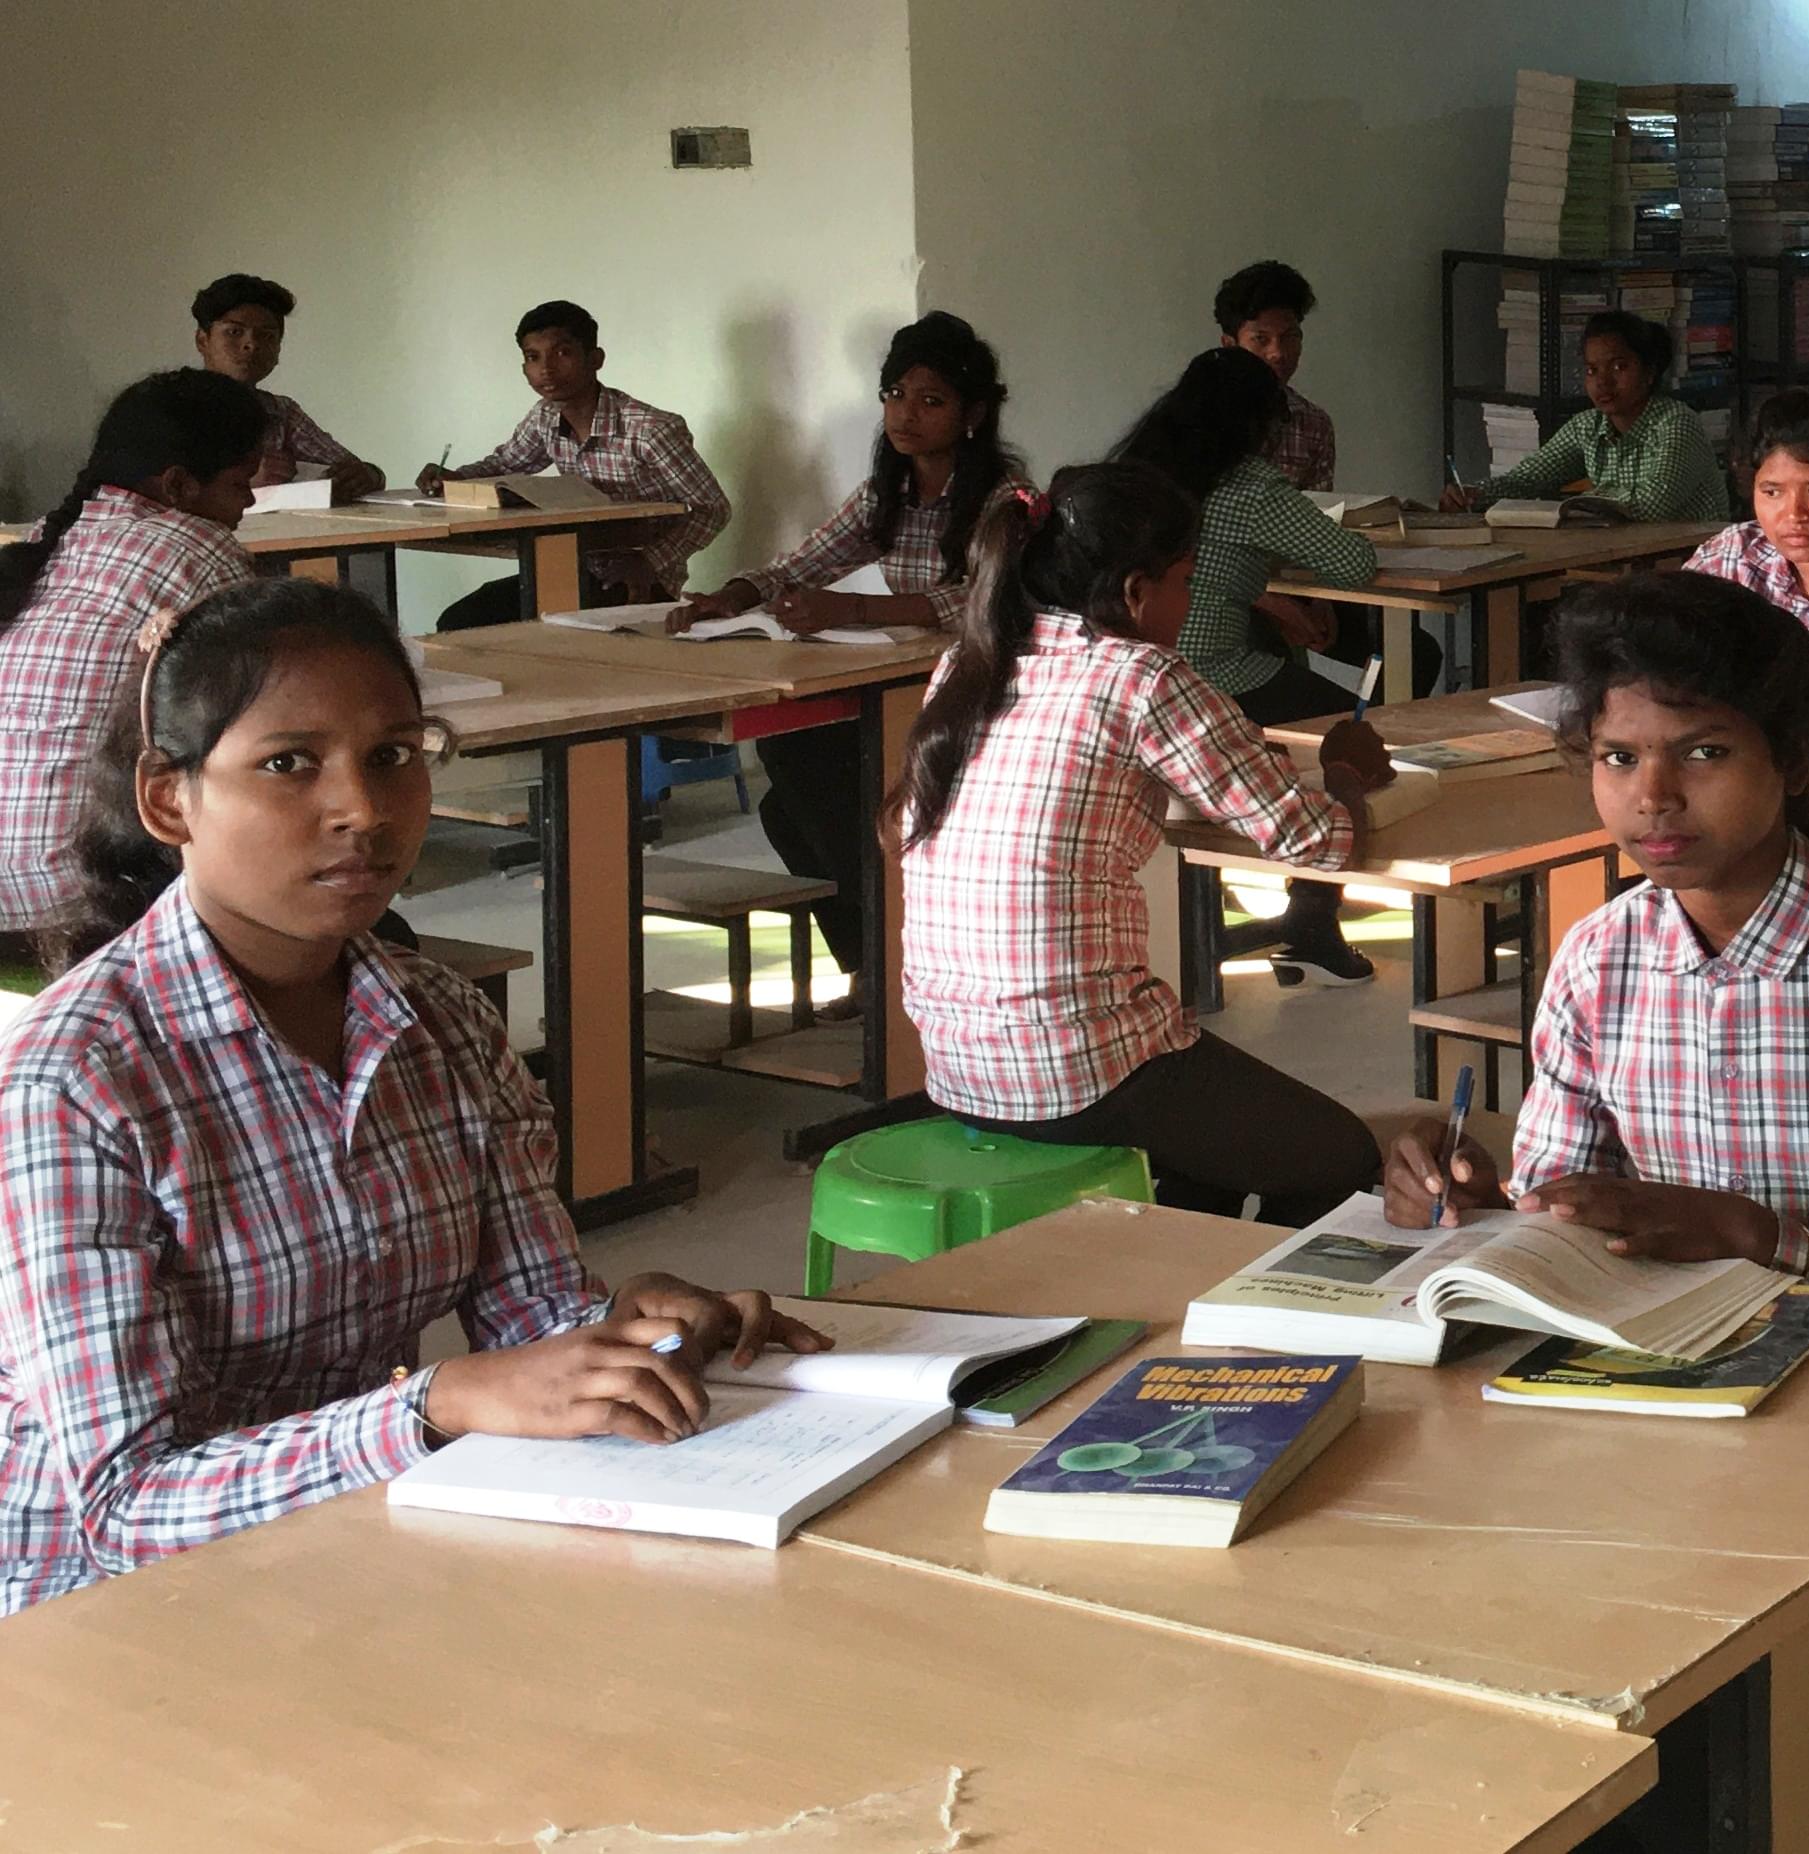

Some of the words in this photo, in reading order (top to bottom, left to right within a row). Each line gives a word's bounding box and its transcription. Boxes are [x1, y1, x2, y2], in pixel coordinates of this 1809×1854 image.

[1236, 1285, 1256, 1294] of
[1261, 1286, 1343, 1303] Principles
[1334, 1286, 1385, 1299] Lifting
[1141, 1364, 1339, 1383] Mechanical
[1135, 1383, 1309, 1402] Vibrations
[1200, 1405, 1253, 1413] SINGH
